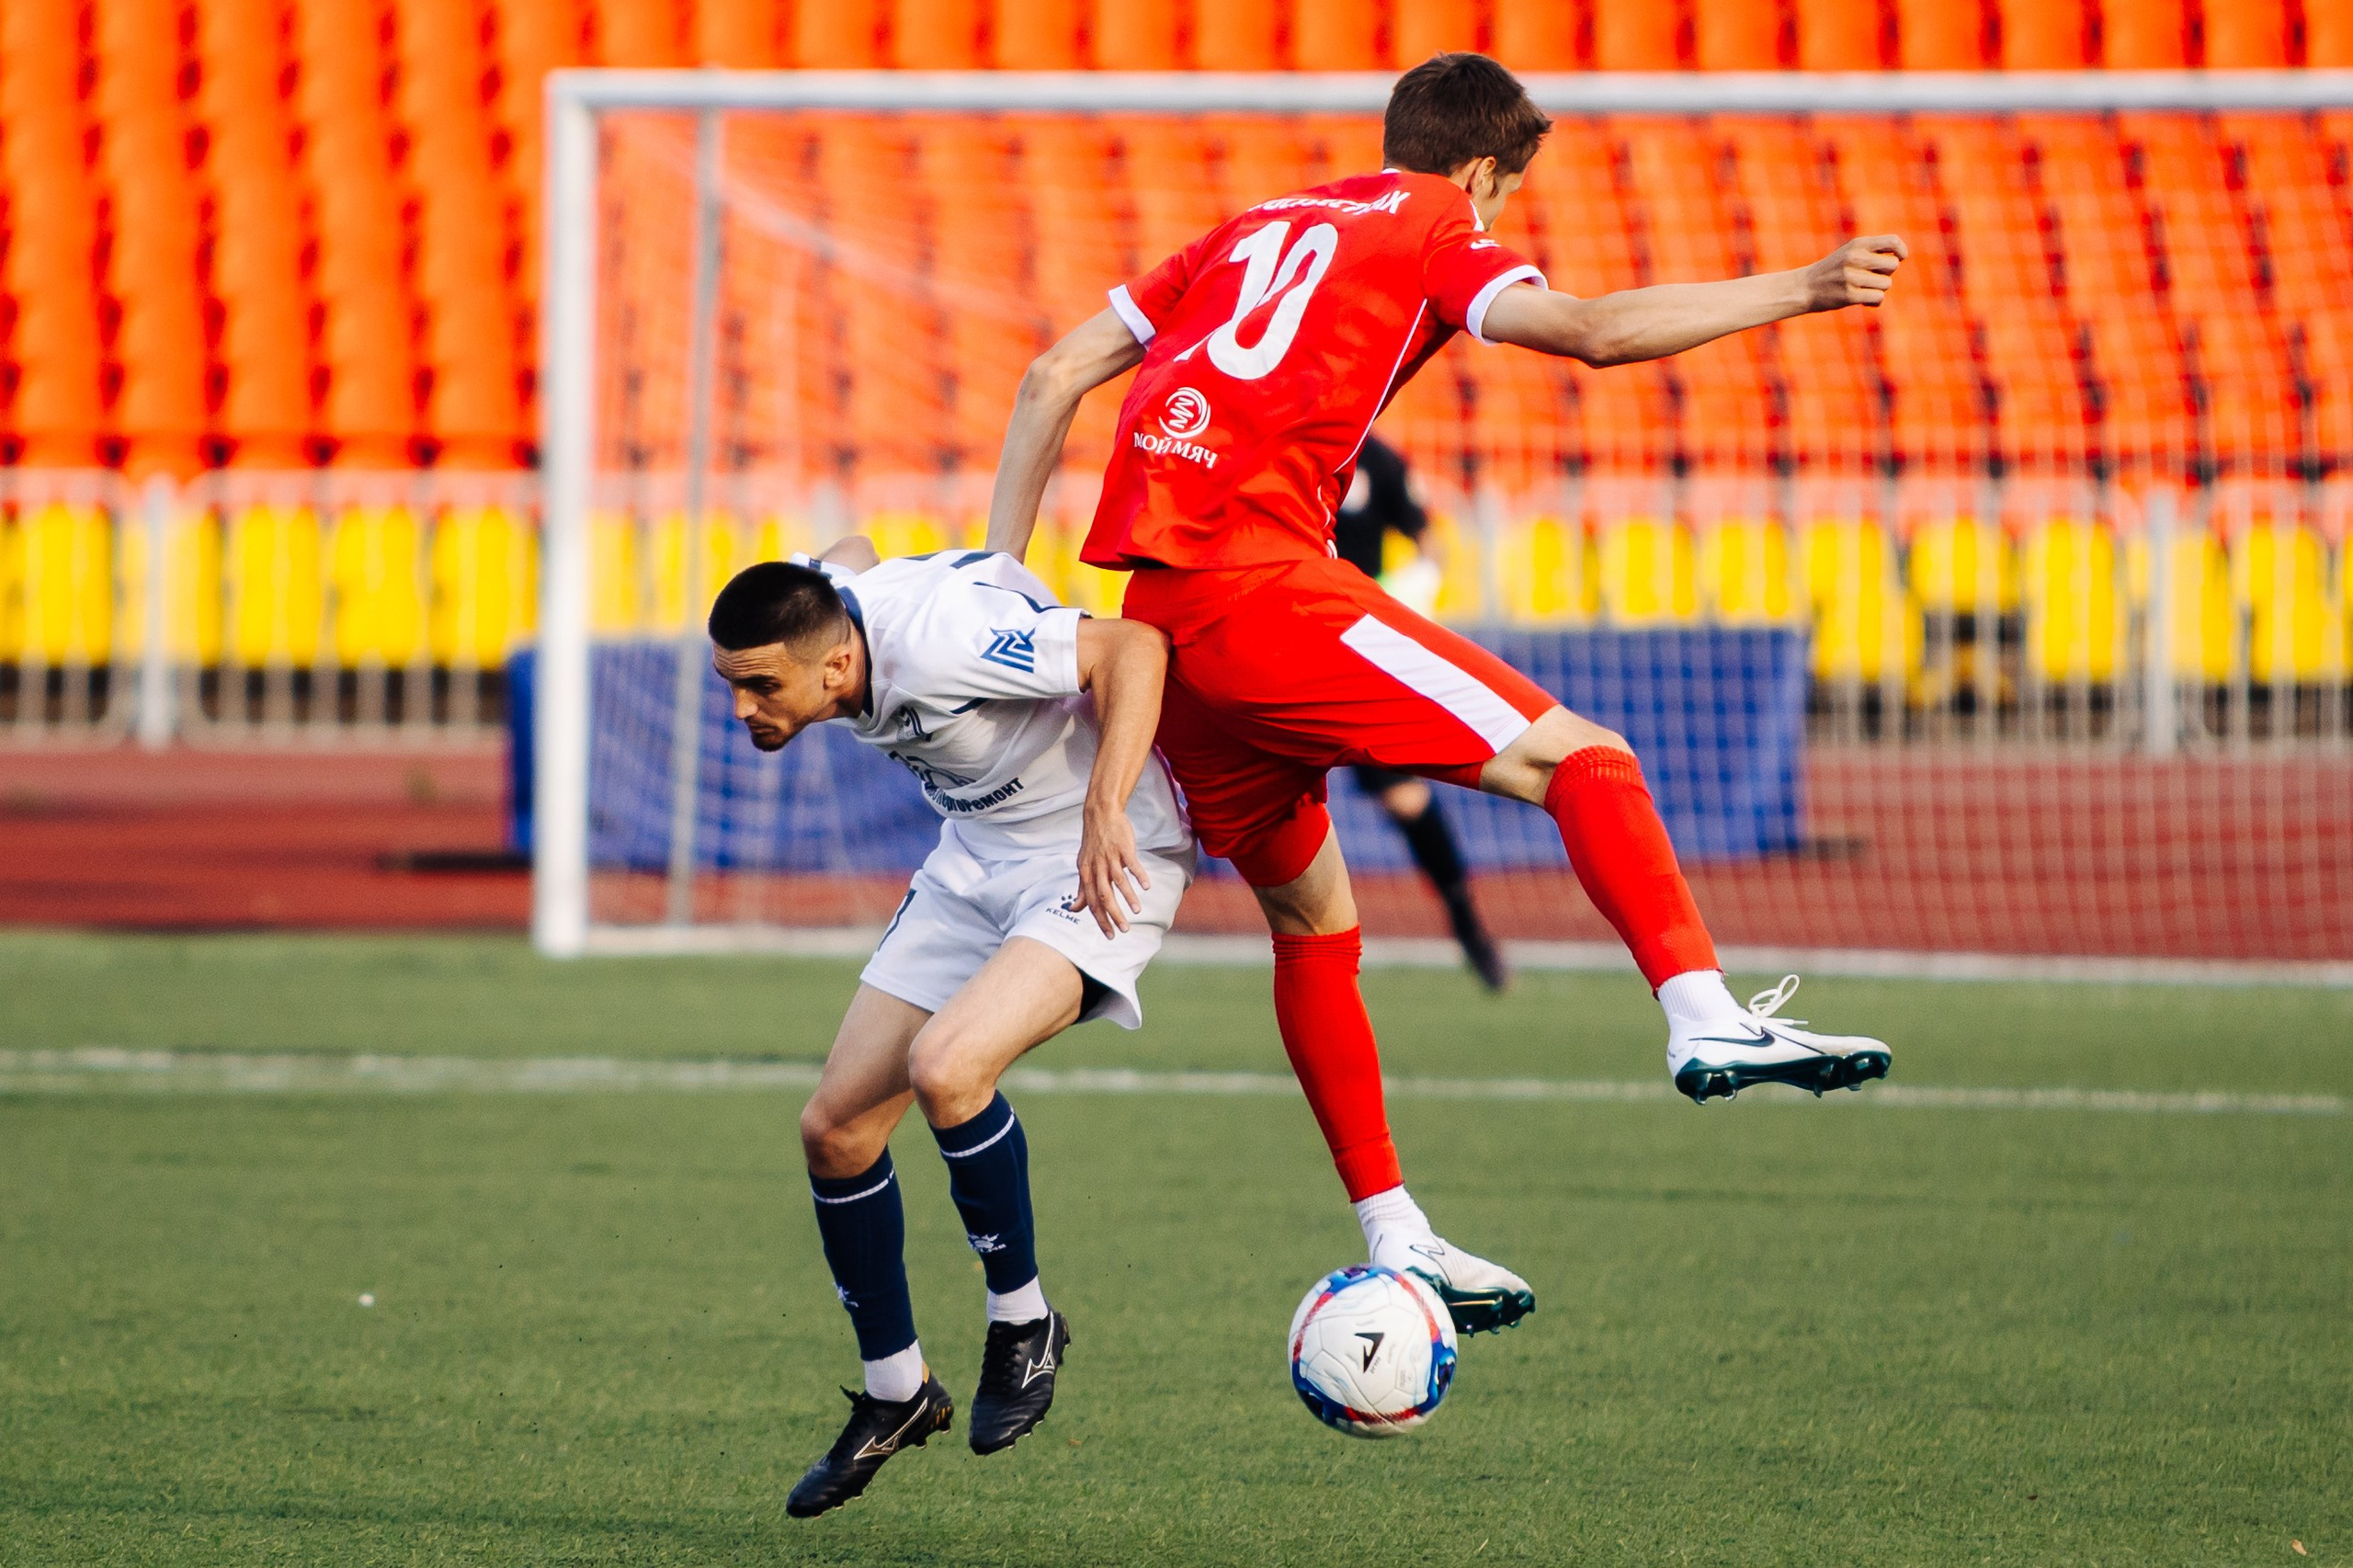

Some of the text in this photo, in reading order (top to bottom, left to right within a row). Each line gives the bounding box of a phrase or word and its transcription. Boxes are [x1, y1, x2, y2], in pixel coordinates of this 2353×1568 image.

[1173, 221, 1339, 381] 10
[1171, 440, 1218, 469] МЯЧ
[1045, 907, 1081, 925] KELME
